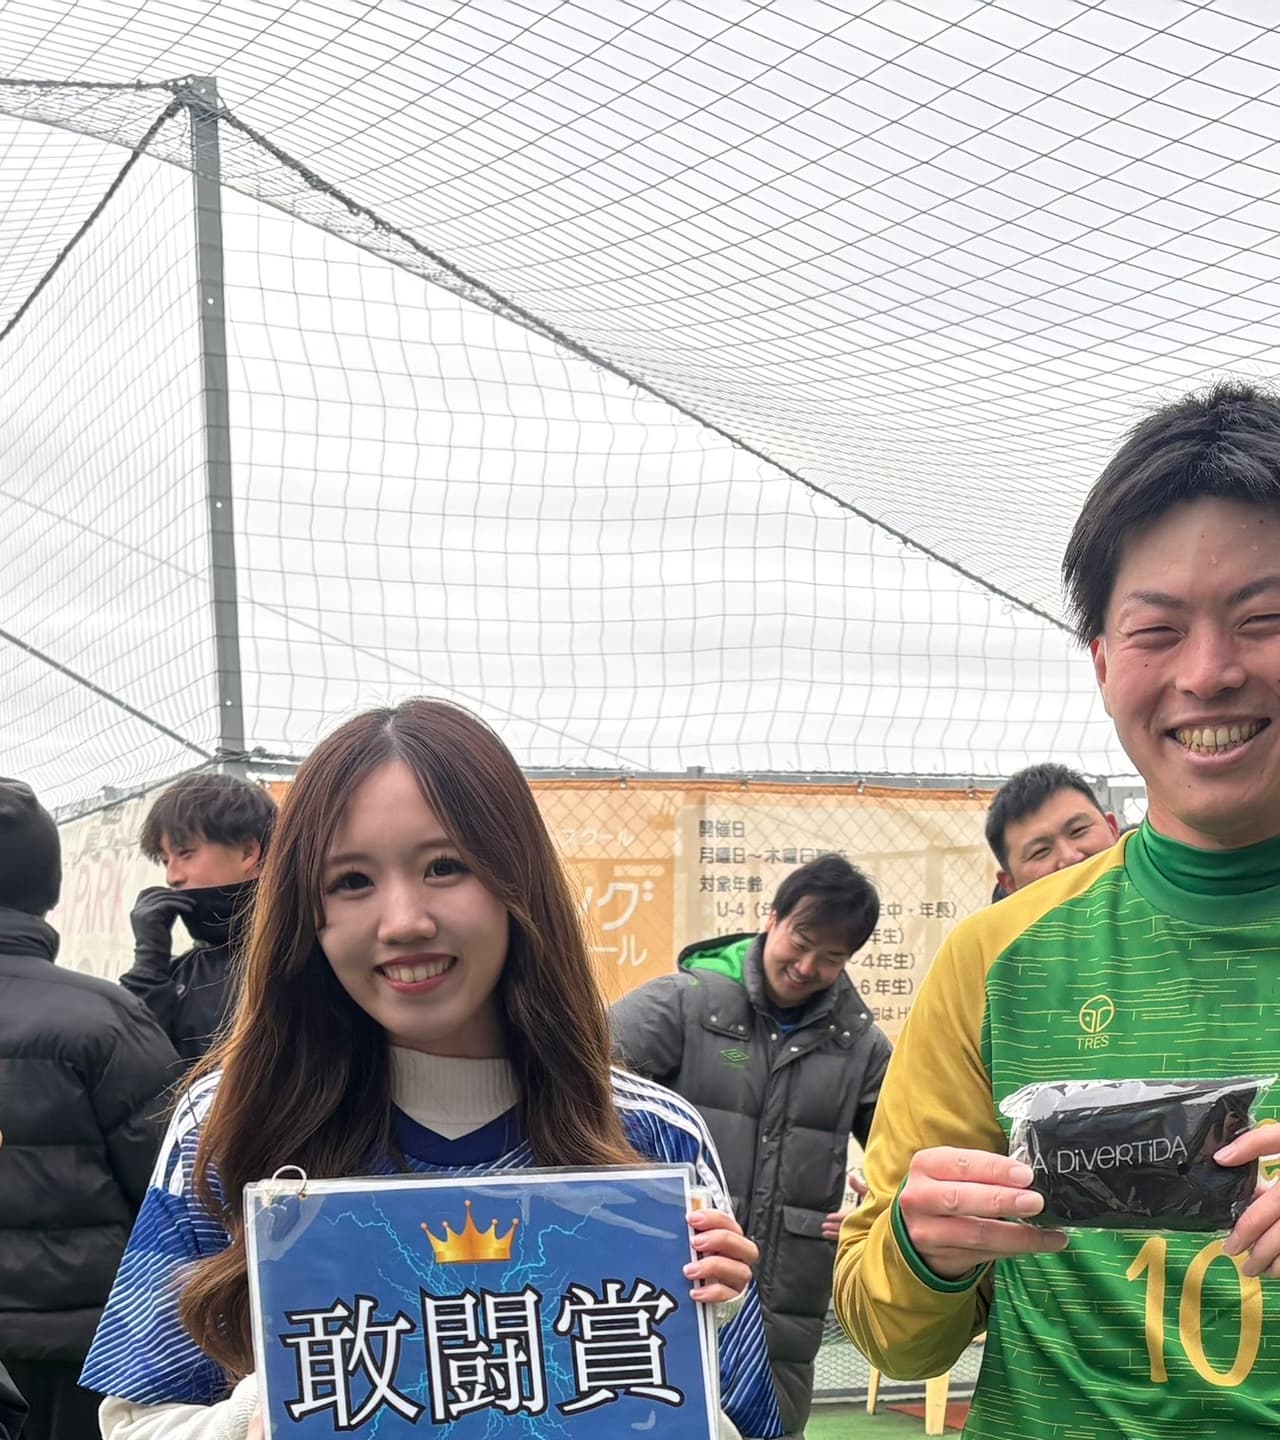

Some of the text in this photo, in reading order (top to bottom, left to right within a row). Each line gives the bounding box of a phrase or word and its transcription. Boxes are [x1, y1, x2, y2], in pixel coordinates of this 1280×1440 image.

[698, 875, 763, 893] 対象年齢
[1076, 1035, 1110, 1051] TRES
[280, 1278, 685, 1431] 敢闘賞
[1126, 1236, 1264, 1388] 10
